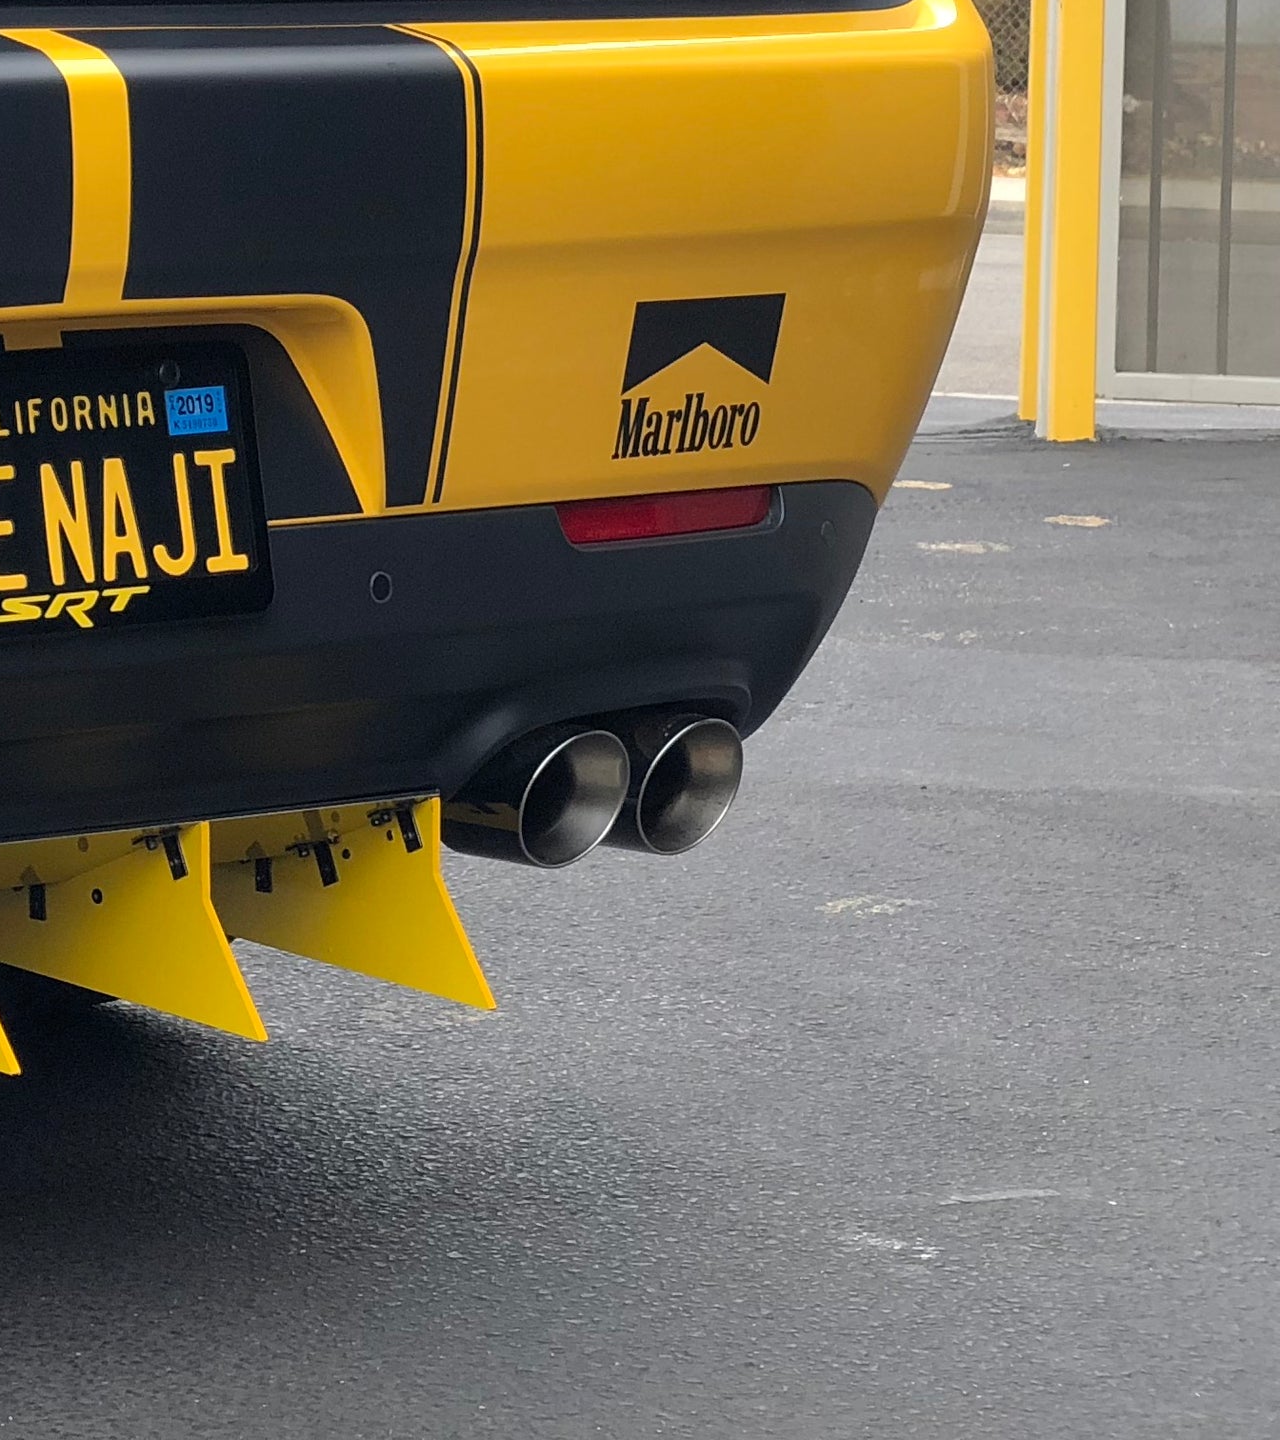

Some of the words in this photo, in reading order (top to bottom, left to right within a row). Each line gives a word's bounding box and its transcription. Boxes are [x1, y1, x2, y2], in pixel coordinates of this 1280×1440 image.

[176, 394, 214, 415] 2019
[611, 392, 761, 459] Marlboro
[40, 448, 250, 586] NAJI
